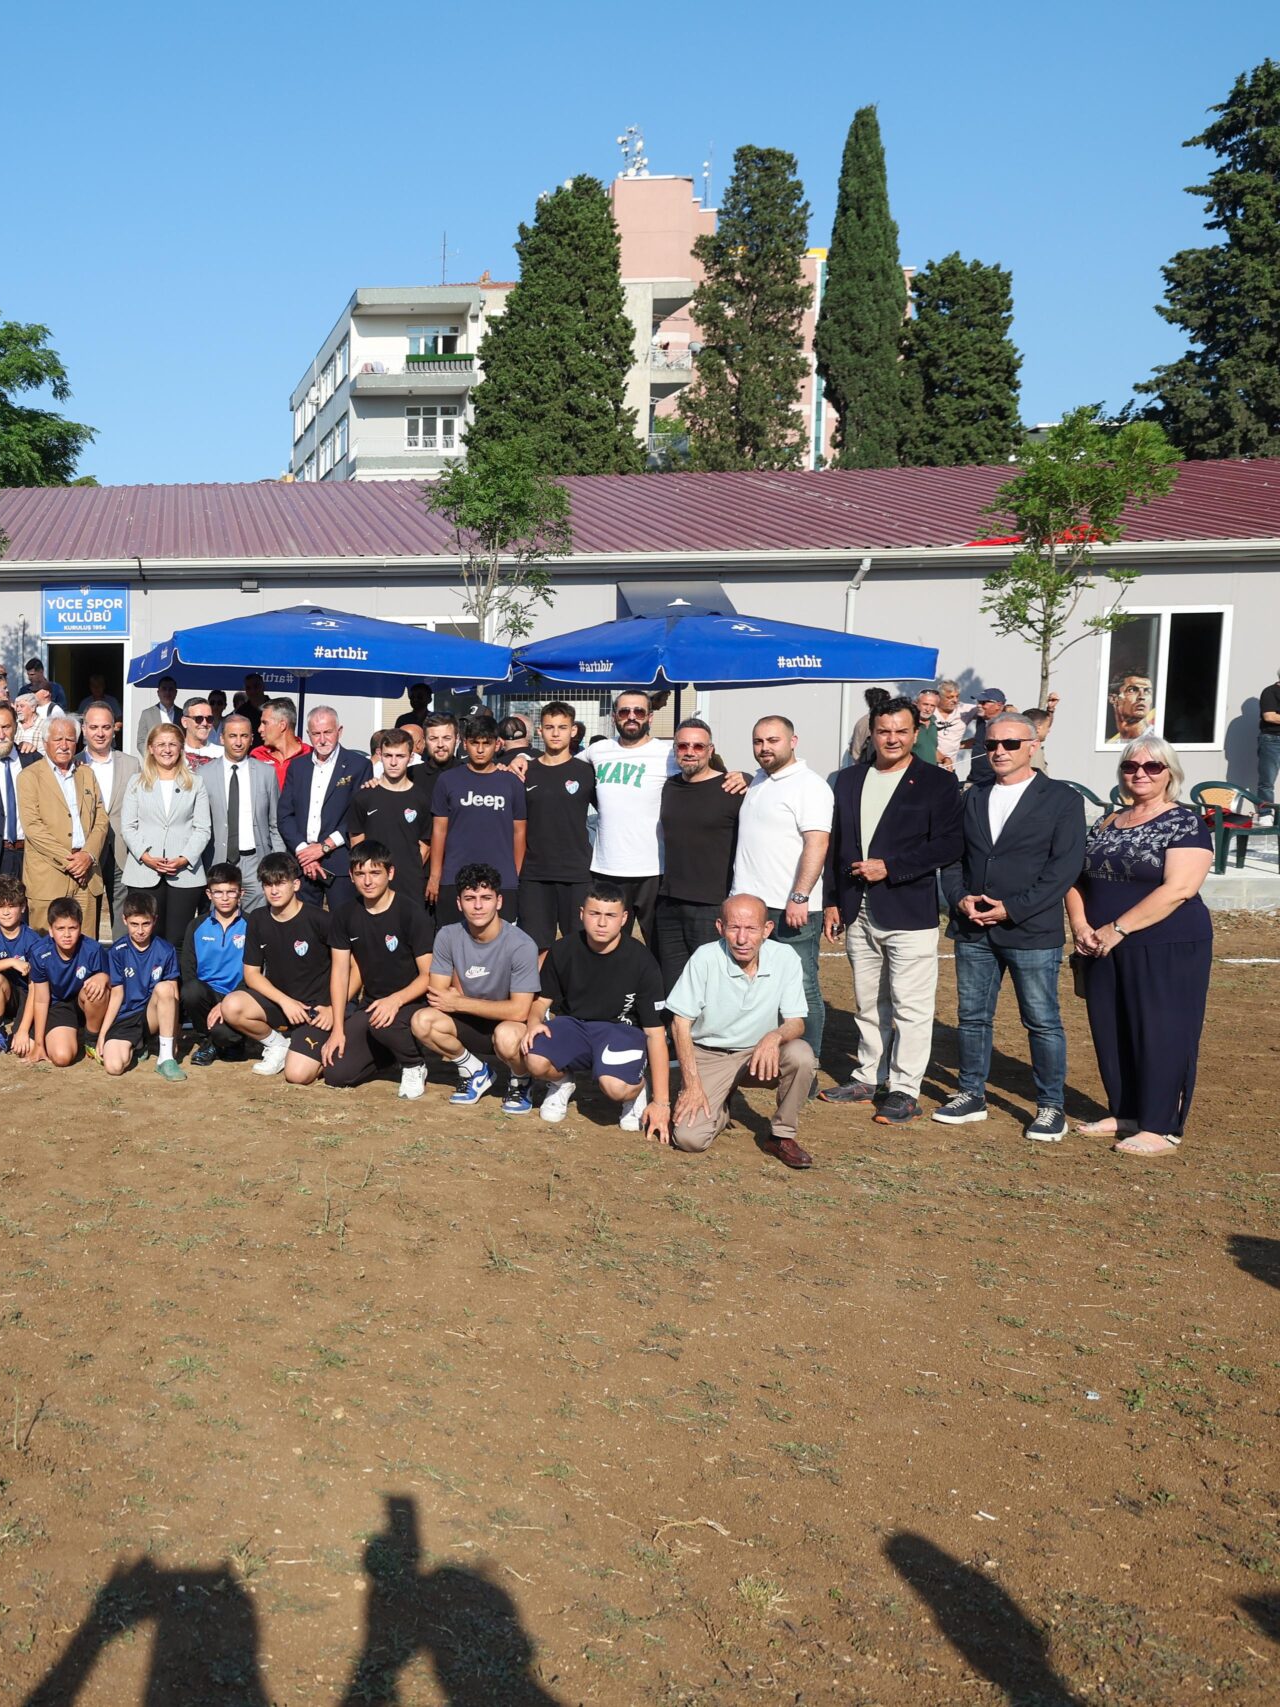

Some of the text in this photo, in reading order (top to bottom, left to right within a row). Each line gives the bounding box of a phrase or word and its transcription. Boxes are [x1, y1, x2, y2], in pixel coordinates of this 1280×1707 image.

[47, 597, 123, 609] YÜCE SPOR
[58, 610, 112, 623] KULÜBÜ
[313, 645, 369, 661] #artıbir
[460, 791, 505, 810] Jeep
